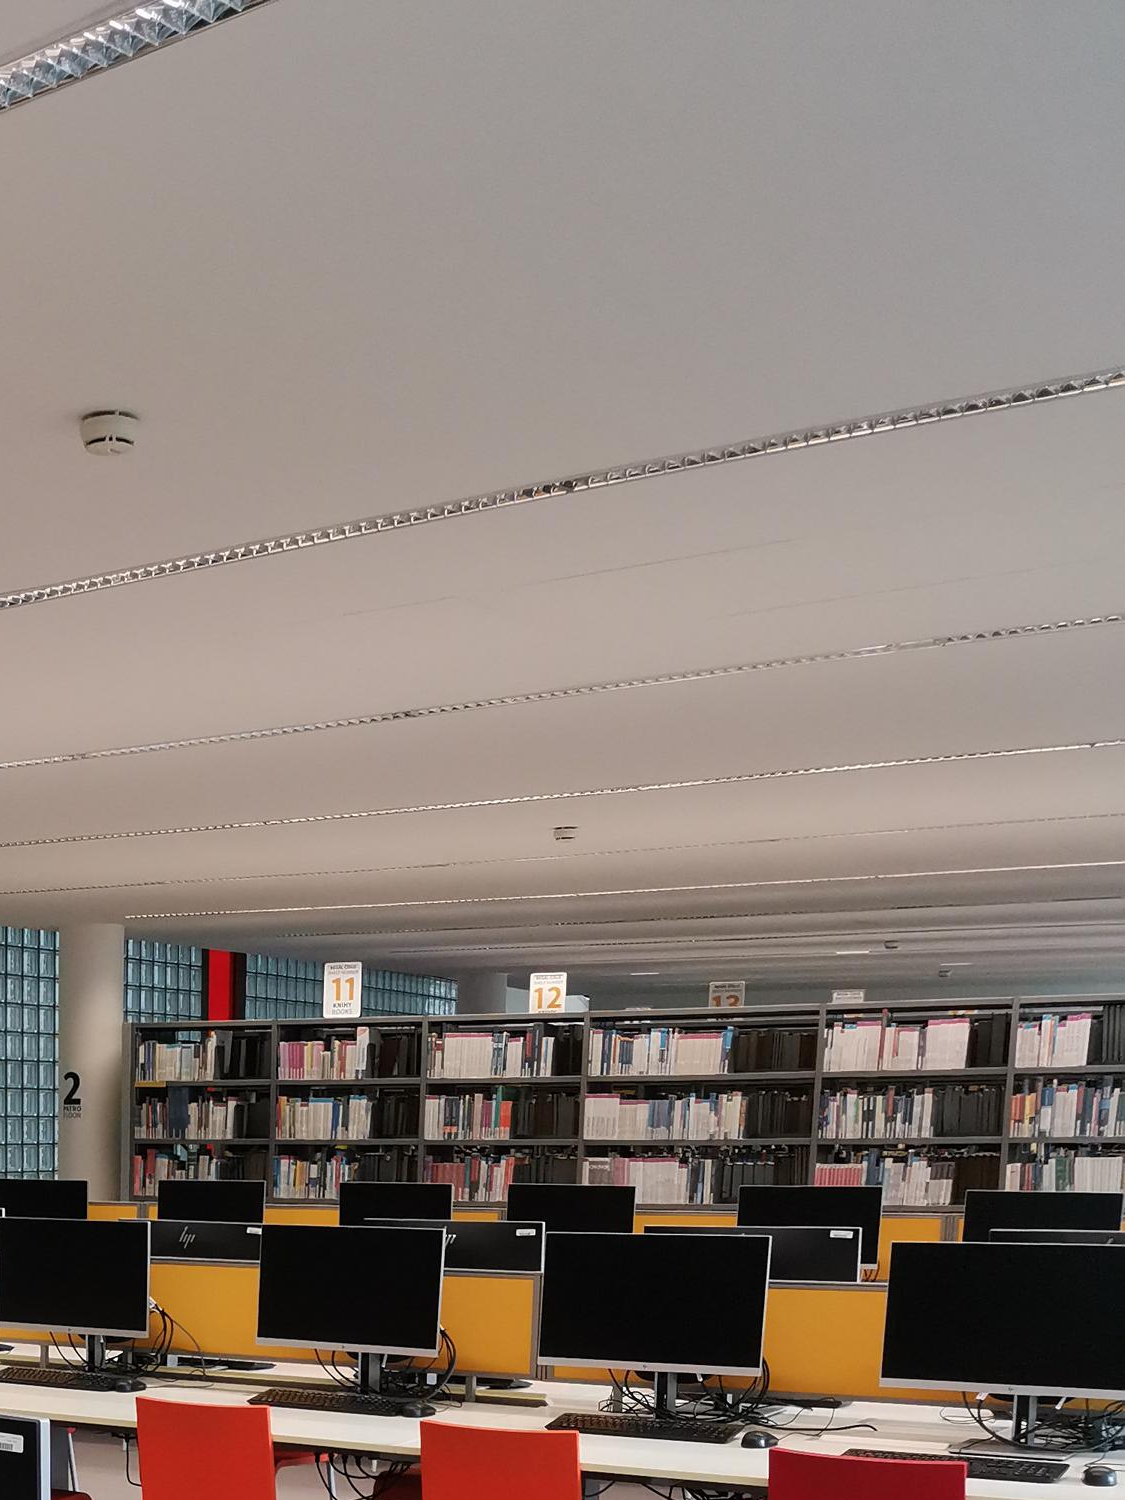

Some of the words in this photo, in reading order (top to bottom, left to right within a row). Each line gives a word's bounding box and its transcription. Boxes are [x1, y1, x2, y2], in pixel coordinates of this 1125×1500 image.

[332, 977, 354, 1000] 11
[534, 986, 562, 1009] 12
[64, 1071, 81, 1105] 2
[179, 1226, 195, 1249] hp
